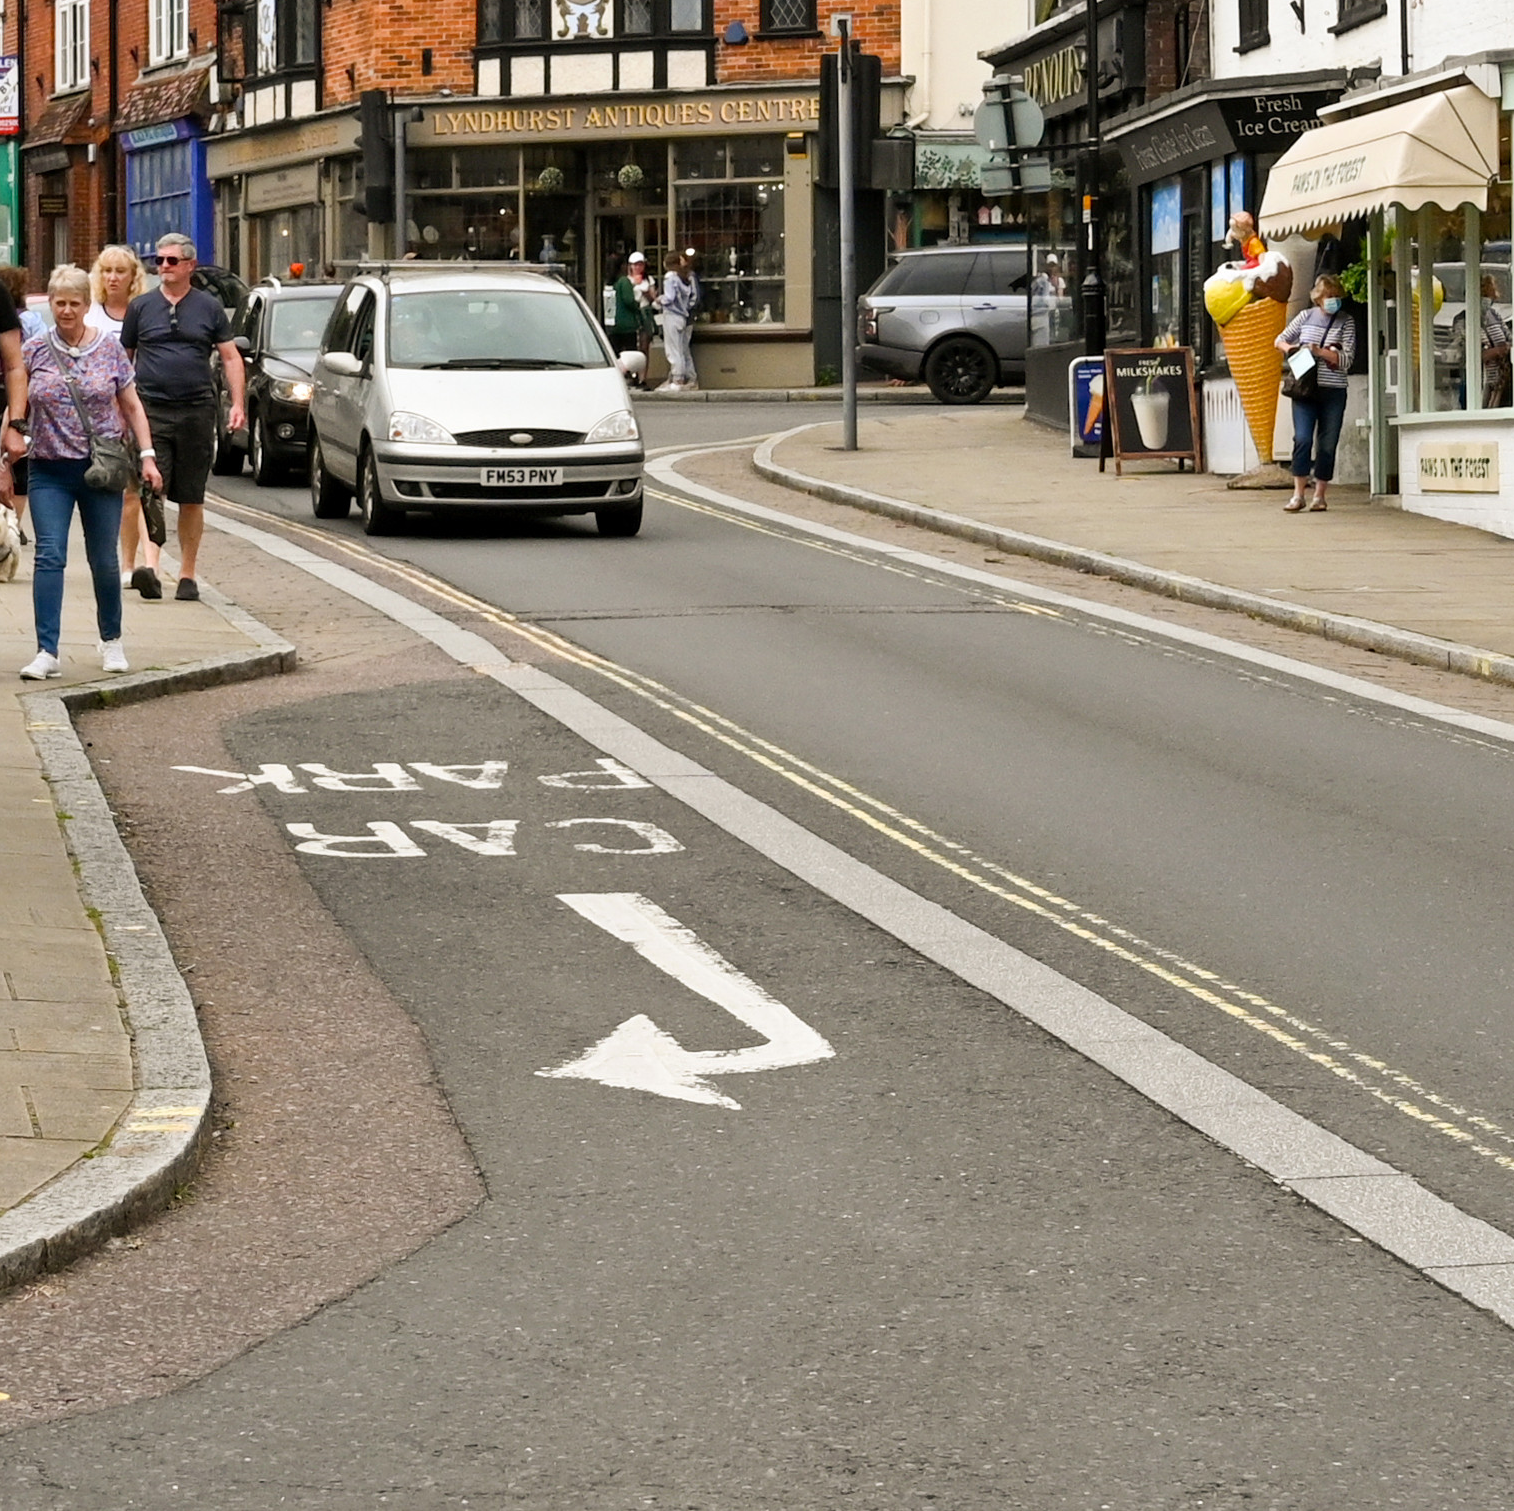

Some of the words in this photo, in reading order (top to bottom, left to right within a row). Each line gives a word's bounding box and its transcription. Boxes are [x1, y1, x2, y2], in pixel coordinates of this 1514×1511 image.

[1253, 94, 1303, 113] Fresh
[433, 108, 577, 135] LYNDHURST
[583, 102, 714, 129] ANTIQUES
[718, 98, 820, 124] CENTRE
[1235, 119, 1265, 137] Ice
[1267, 117, 1324, 134] Cream
[1335, 155, 1367, 185] FOREST
[1116, 365, 1183, 377] MILKSHAKES
[486, 469, 525, 483] FM53
[528, 469, 558, 483] PNY
[1420, 457, 1438, 478] PAWS
[1450, 457, 1463, 478] THE
[1465, 457, 1490, 478] FOREST
[170, 758, 654, 793] PARK
[286, 817, 687, 858] CAR
